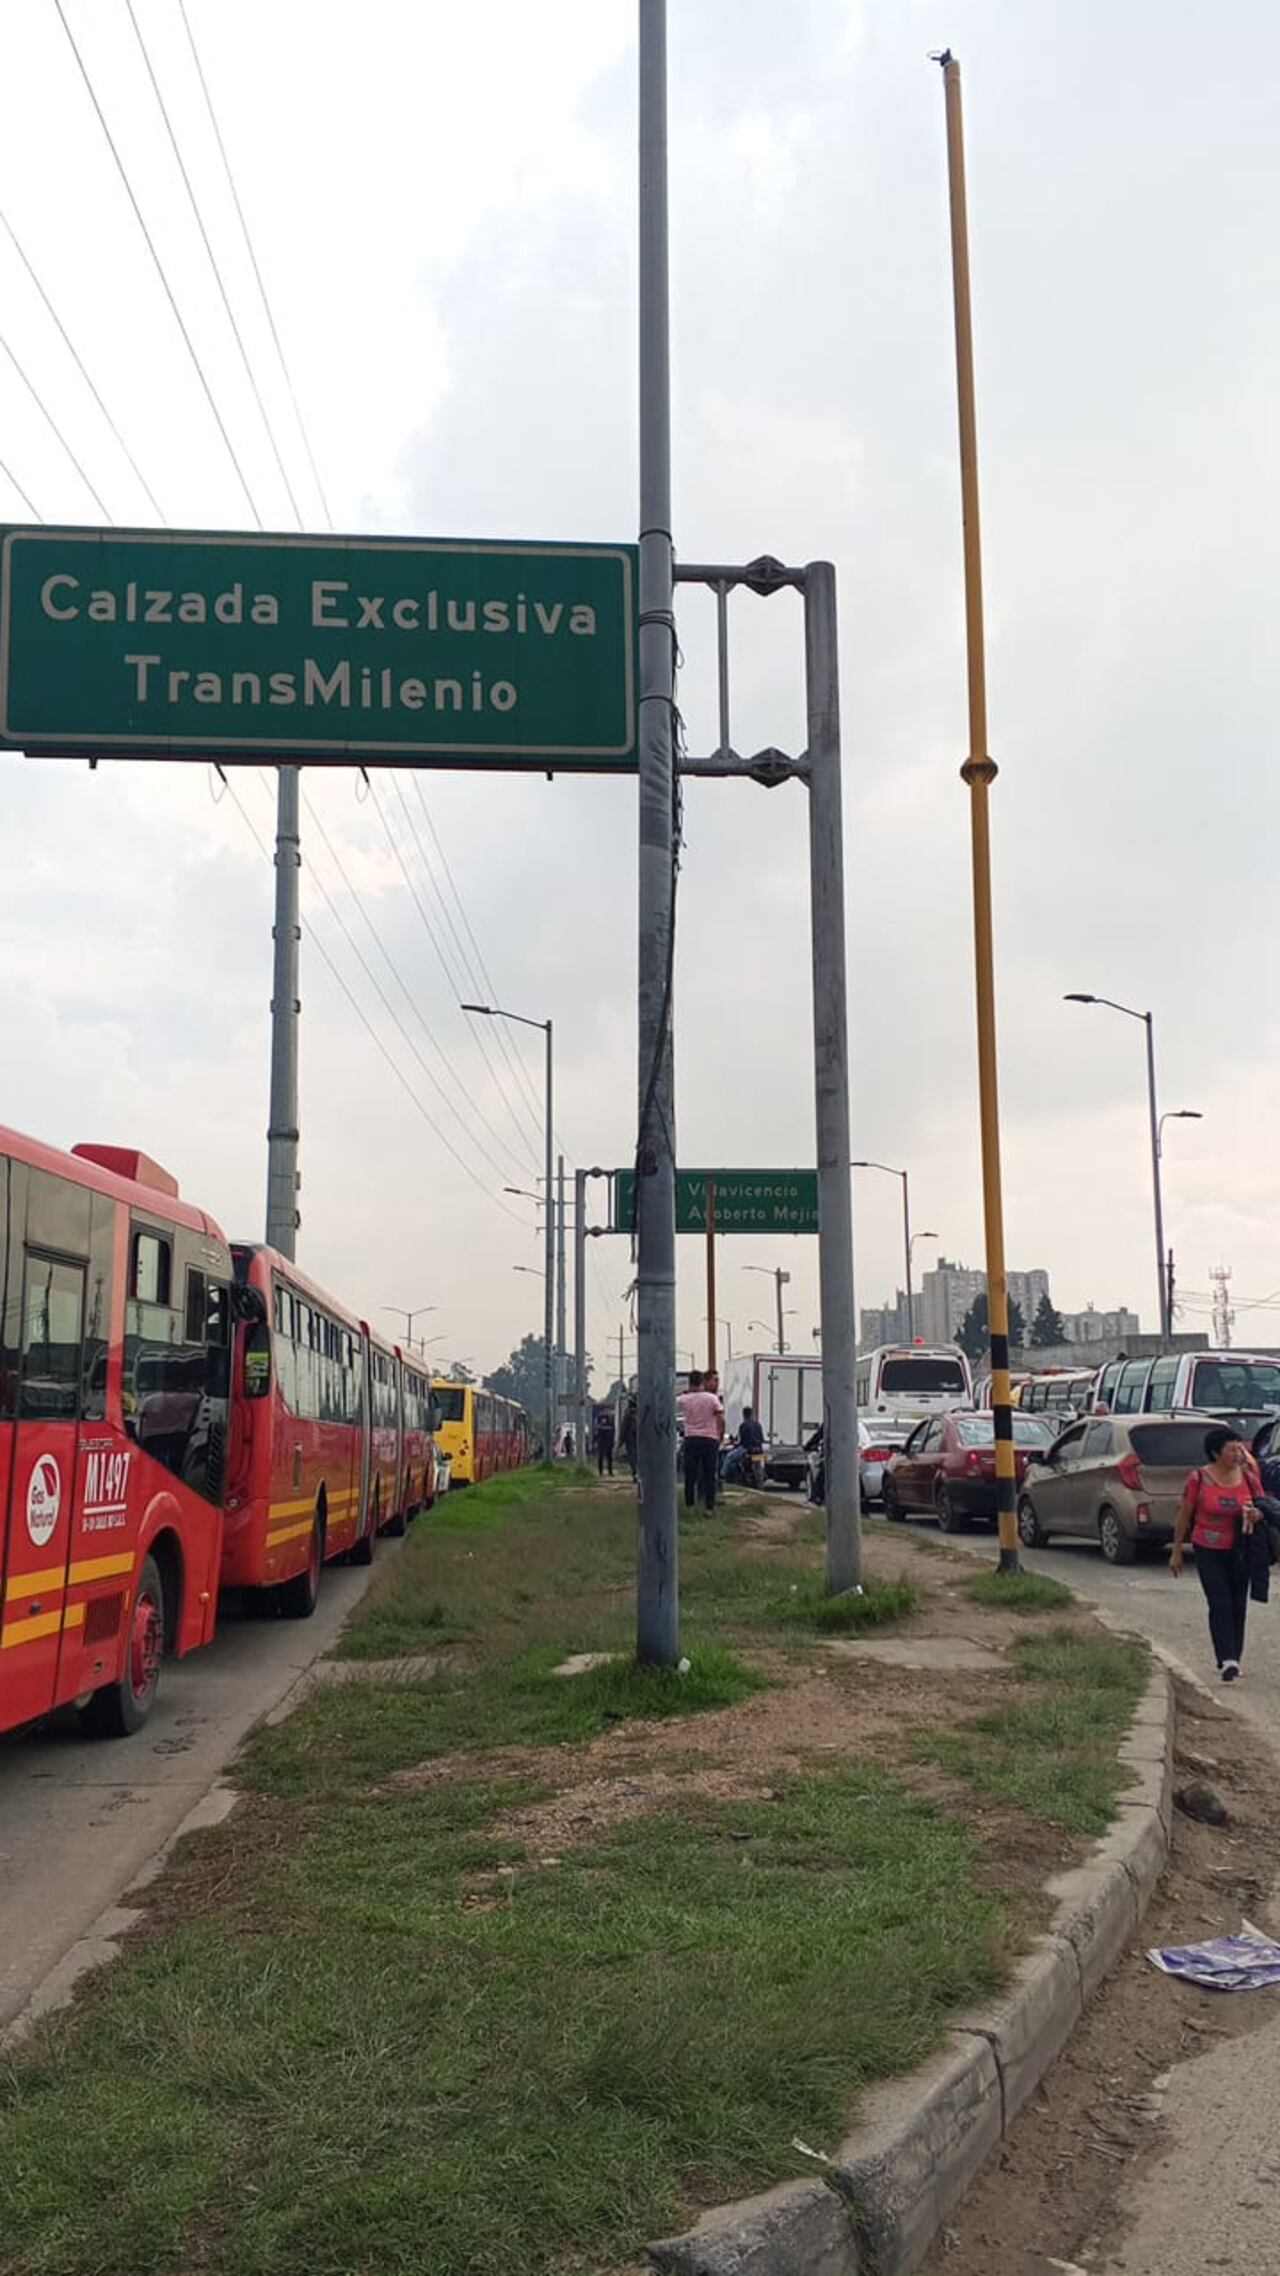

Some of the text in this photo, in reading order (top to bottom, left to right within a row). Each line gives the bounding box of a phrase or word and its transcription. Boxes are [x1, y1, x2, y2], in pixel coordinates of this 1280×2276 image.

[41, 574, 598, 636] Calzada Exclusiva
[125, 655, 518, 712] TransMilenio
[688, 1183, 798, 1197] Vilavicencio
[84, 1452, 131, 1504] M1497
